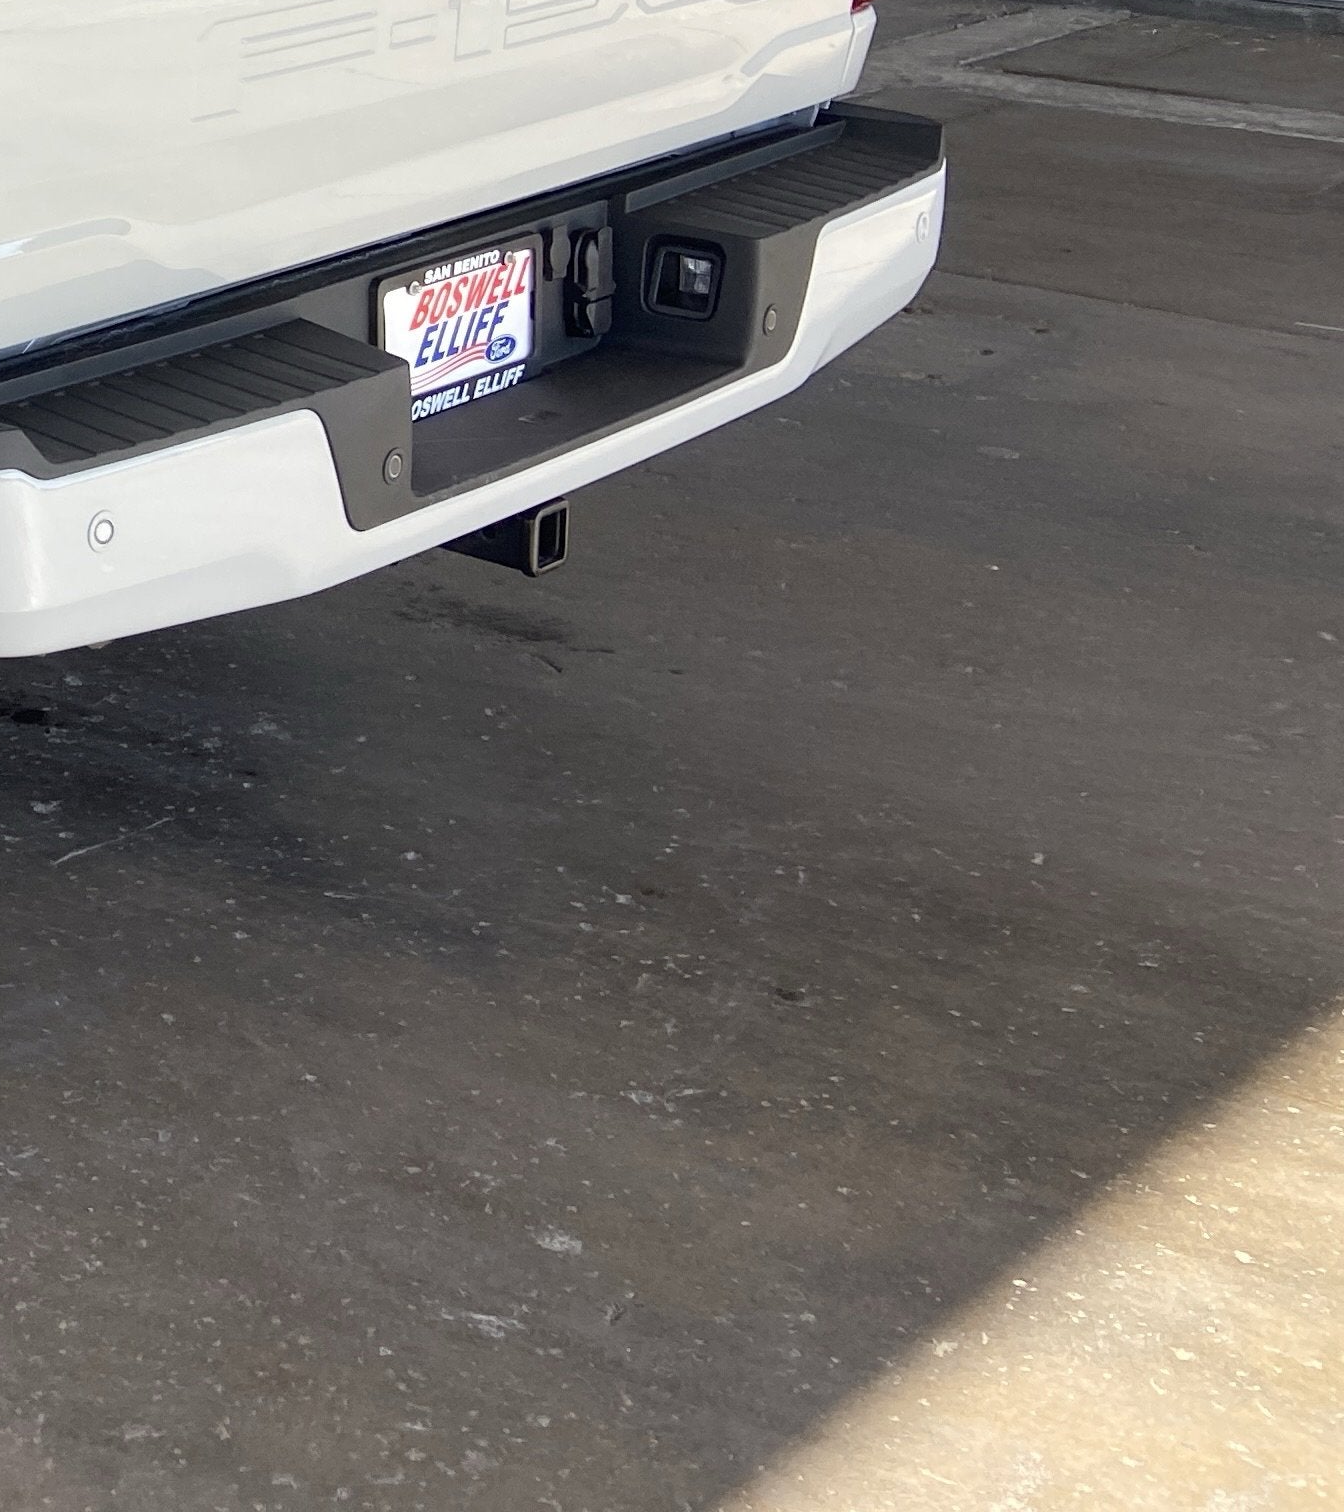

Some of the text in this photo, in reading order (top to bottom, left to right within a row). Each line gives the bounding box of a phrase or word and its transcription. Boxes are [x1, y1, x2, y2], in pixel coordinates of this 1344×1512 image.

[409, 255, 530, 331] BOSWELL
[424, 249, 500, 285] SAN BENITO
[414, 300, 509, 368] ELLIFF
[411, 364, 526, 421] OSWELL ELLIFF
